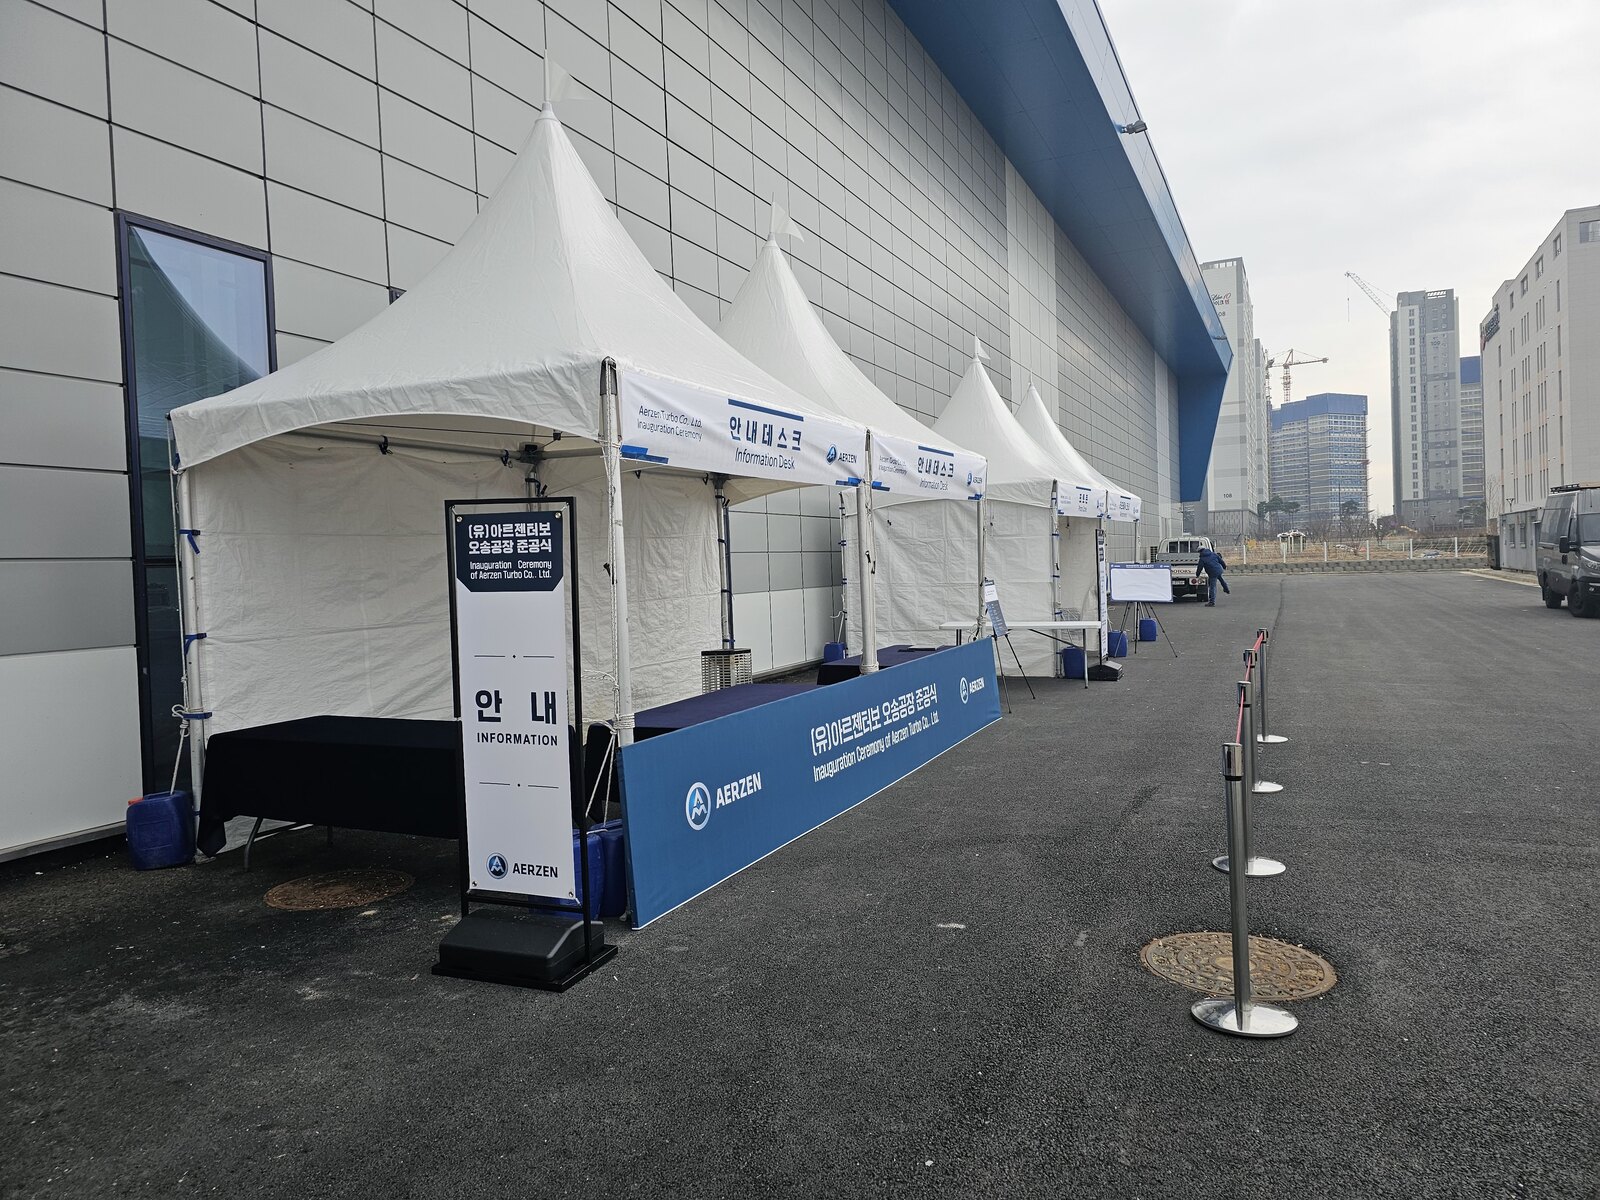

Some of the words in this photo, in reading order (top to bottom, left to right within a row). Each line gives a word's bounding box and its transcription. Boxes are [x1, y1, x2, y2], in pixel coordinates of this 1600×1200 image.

[639, 405, 661, 419] Aerzen
[661, 410, 679, 423] Turbo
[637, 419, 675, 435] Inauguration
[676, 426, 703, 442] Ceremony
[735, 447, 779, 468] Information
[779, 454, 796, 470] Desk
[838, 452, 857, 463] AERZEN
[468, 522, 552, 538] (유)아르젠터보
[468, 540, 514, 554] 오송공장
[517, 539, 552, 553] 준공식
[469, 561, 512, 570] Inauguration
[517, 559, 552, 570] Ceremony
[470, 570, 478, 580] of
[478, 570, 503, 579] Aerzen
[503, 570, 523, 579] Turbo
[538, 569, 552, 578] Ltd.
[811, 706, 882, 757] (유)아르젠터보
[882, 690, 915, 727] 오송공장
[915, 682, 938, 712] 준공식
[476, 732, 558, 746] INFORMATION
[813, 752, 857, 783] Inauguration
[856, 737, 885, 762] Ceremony
[884, 733, 892, 749] of
[891, 724, 910, 746] Aerzen
[909, 718, 922, 737] Turbo
[930, 710, 940, 726] Ltd.
[715, 771, 762, 809] AERZEN
[512, 862, 559, 878] AERZEN
